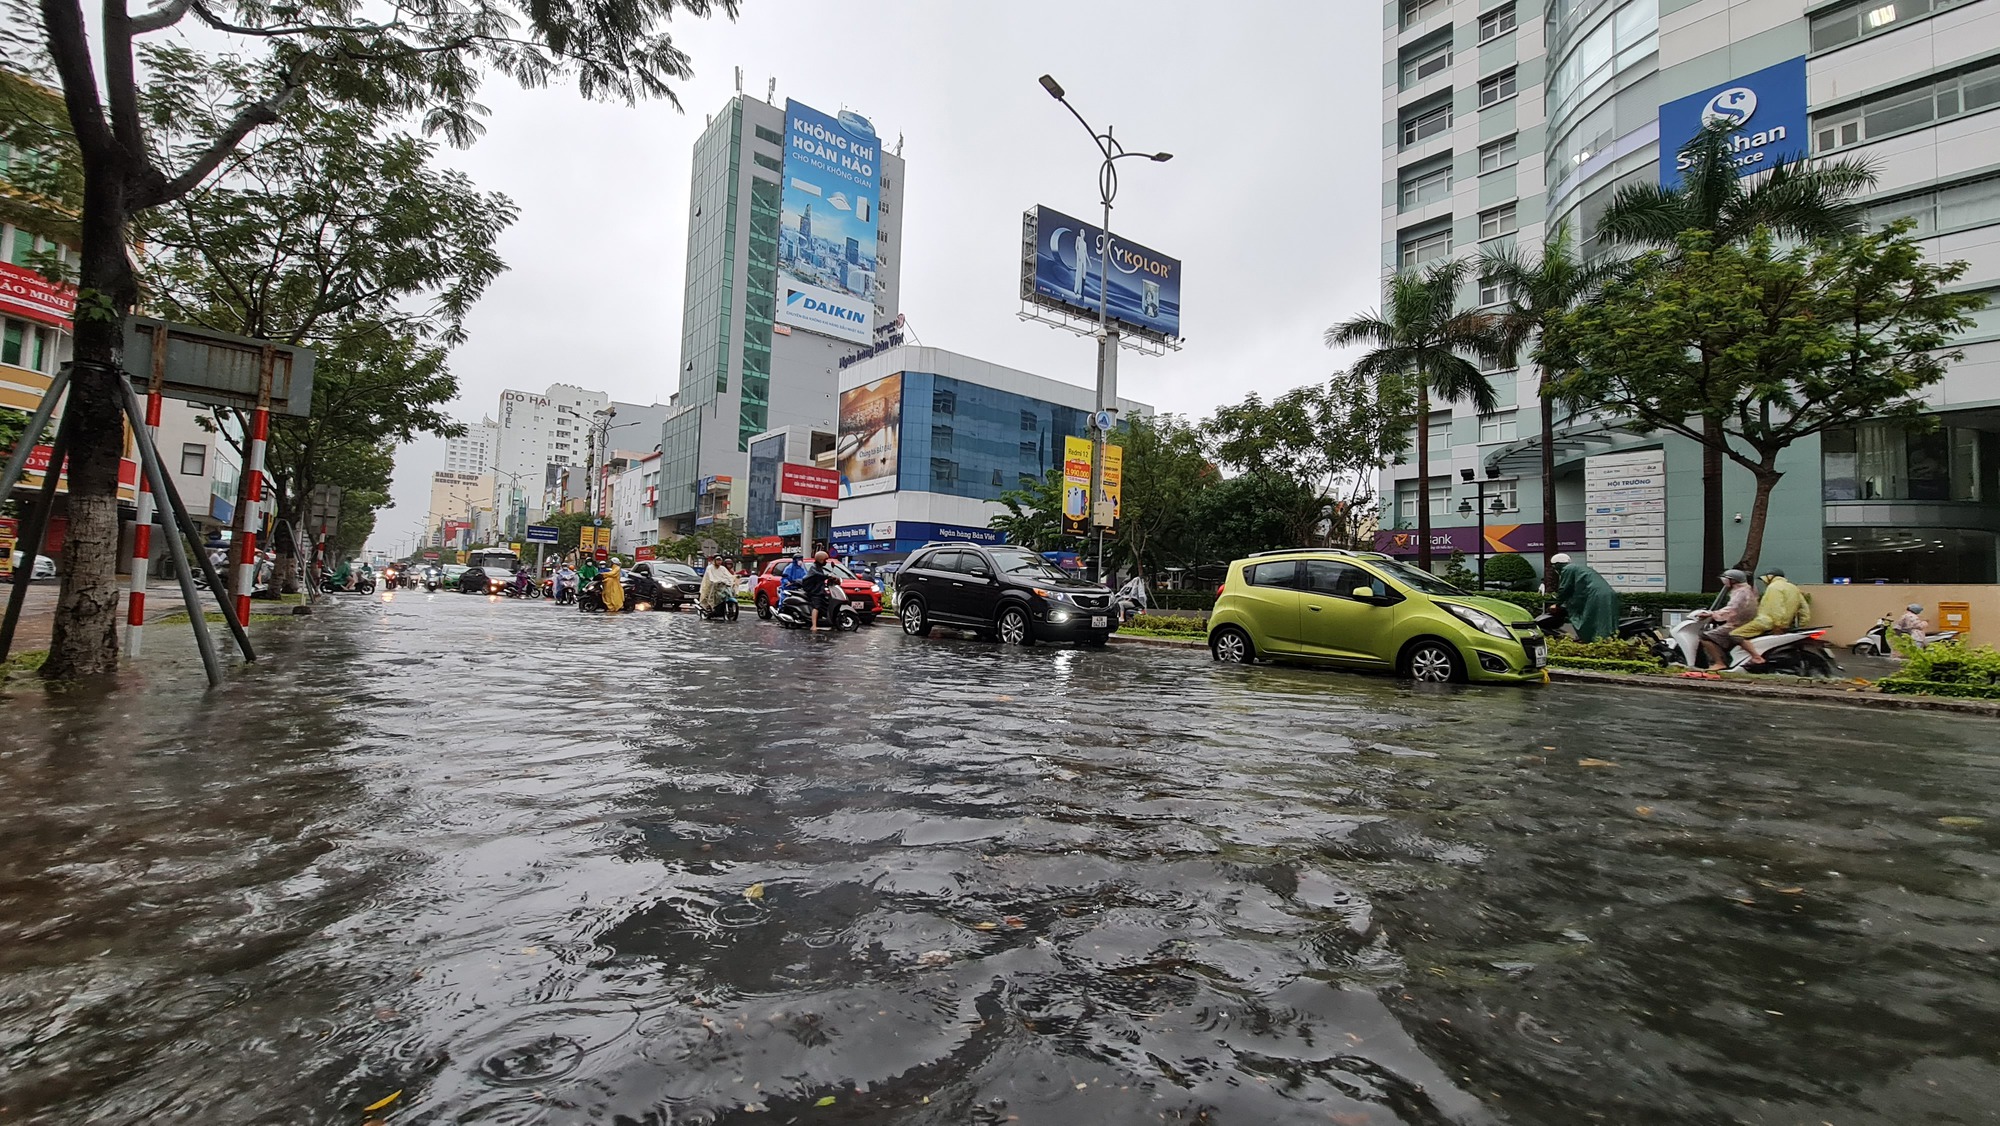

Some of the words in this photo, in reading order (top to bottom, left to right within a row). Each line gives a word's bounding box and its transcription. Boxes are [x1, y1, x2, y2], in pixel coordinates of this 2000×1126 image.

[793, 117, 847, 149] KHÔNG
[850, 141, 873, 161] KHÍ
[793, 136, 838, 163] HOÀN
[841, 155, 872, 177] HẢO
[792, 152, 809, 163] CHO
[810, 159, 825, 170] MỌI
[826, 165, 853, 180] KHÔNG
[854, 177, 872, 188] GIAN
[29, 288, 70, 308] MINH
[803, 297, 865, 324] DAIKIN
[505, 392, 525, 402] DO
[529, 396, 551, 407] HAI
[504, 401, 513, 429] HOTEL
[1068, 448, 1083, 457] Redmi
[457, 473, 479, 481] GROUP
[1607, 479, 1621, 487] HỘI
[1622, 478, 1651, 486] TRƯỜNG
[939, 528, 956, 537] Ngân
[956, 530, 972, 539] hàng
[972, 531, 984, 540] Bản
[984, 532, 996, 541] Việt
